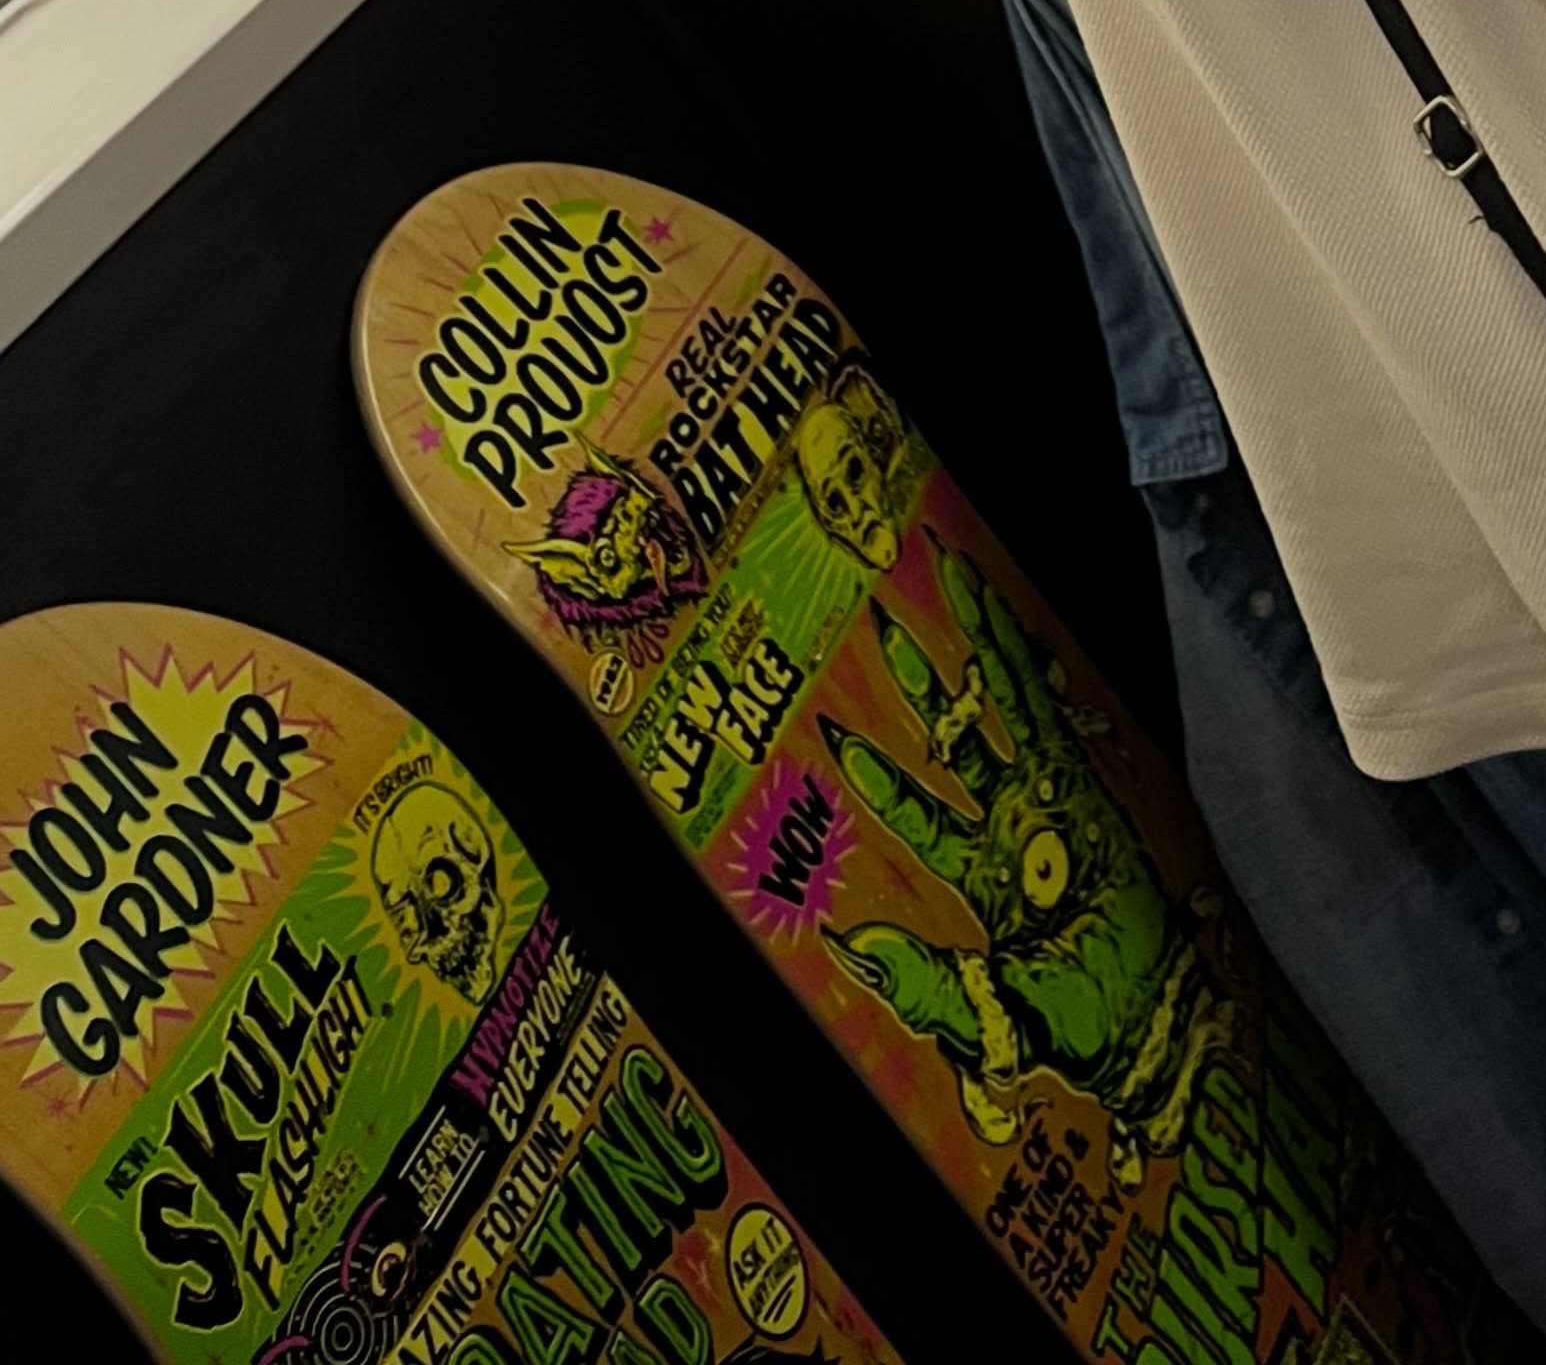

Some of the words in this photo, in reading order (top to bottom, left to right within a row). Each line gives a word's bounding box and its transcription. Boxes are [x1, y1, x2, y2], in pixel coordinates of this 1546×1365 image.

[419, 199, 581, 423] COLLIN
[464, 211, 661, 508] PROVOST
[650, 273, 796, 472] ROCKSTAR
[666, 307, 736, 397] REAL
[674, 406, 754, 547] BAT
[739, 299, 840, 441] HEAD
[650, 661, 732, 813] NEW
[656, 671, 675, 699] OF
[714, 638, 804, 765] FACE
[10, 702, 177, 940] JOHN
[41, 694, 308, 1075] GARDNER
[759, 773, 835, 907] WOW
[449, 901, 561, 1109] HYPNOTIZE
[488, 933, 582, 1143] EVERYONE
[104, 1137, 157, 1200] NEW!
[140, 924, 341, 1329] SKULL
[243, 954, 372, 1310] FLASHLIGHT
[408, 1118, 460, 1195] LEARN
[417, 1165, 454, 1220] HOW
[448, 1131, 477, 1165] TO
[476, 1103, 574, 1265] FORTUNE
[557, 990, 627, 1115] TELLING
[987, 1162, 1033, 1238] ONE
[1022, 1119, 1052, 1171] OF
[1008, 1233, 1034, 1269] A
[1022, 1154, 1074, 1239] KIND
[1065, 1128, 1090, 1160] &
[733, 1238, 767, 1291] ASK
[760, 1217, 783, 1254] IT
[1028, 1183, 1095, 1294] SUPER
[1049, 1182, 1125, 1321] FREAKY
[1092, 1212, 1158, 1358] THE
[1134, 1065, 1262, 1365] URSED
